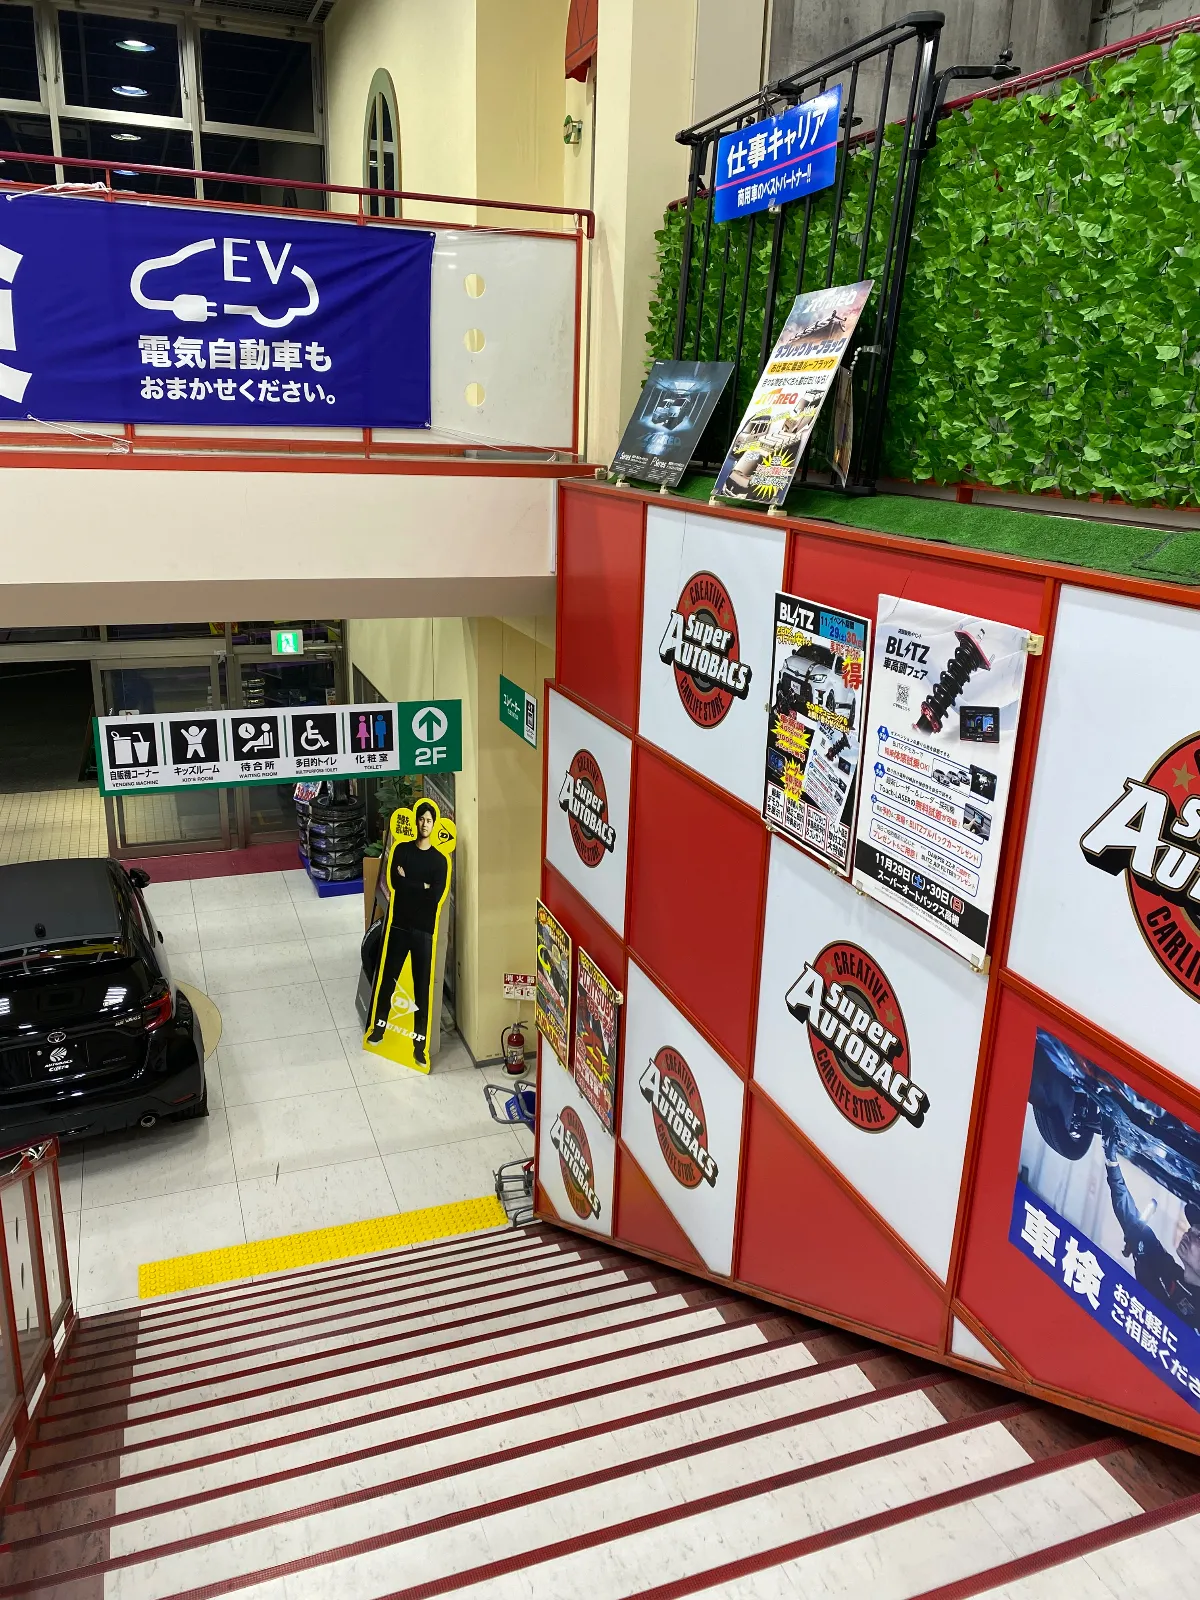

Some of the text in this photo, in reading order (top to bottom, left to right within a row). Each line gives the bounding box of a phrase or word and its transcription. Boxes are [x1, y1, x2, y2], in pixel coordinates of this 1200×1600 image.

[727, 108, 829, 178] 仕事キャリア
[223, 237, 292, 285] EV
[138, 334, 332, 373] 電気自動車も
[140, 375, 336, 405] おまかせください。
[690, 580, 725, 613] CREATIVE
[780, 602, 815, 631] BLITZ
[659, 609, 751, 692] AUTOBACS
[685, 614, 732, 652] Super
[885, 635, 930, 665] BLITZ
[680, 676, 725, 722] CARLIFE STORE
[842, 662, 863, 691] 得
[110, 769, 160, 781] 自販機コーナー
[174, 764, 220, 776] キッズルーム
[240, 761, 275, 772] 待合所
[295, 756, 337, 768] 多目的トイレ
[355, 753, 389, 764] 化粧室
[415, 746, 447, 766] 2F
[576, 756, 600, 782] CREATIVE
[558, 770, 616, 848] AUTOBACS
[575, 779, 604, 812] Super
[875, 852, 965, 915] 11月29日(土)・30日(日)
[578, 968, 614, 1023] FUJITSUBO
[834, 951, 888, 1009] CREATIVE
[376, 1019, 426, 1042] DUNLOP
[785, 962, 928, 1118] AUTOBACS
[825, 981, 900, 1055] Super
[664, 1053, 696, 1098] CREATIVE
[816, 1048, 886, 1123] CARLIFE STORE
[639, 1058, 716, 1178] AUTOBACS
[661, 1075, 702, 1131] Super
[550, 1114, 599, 1212] AUTOBACS
[564, 1129, 590, 1176] Super
[658, 1122, 696, 1182] CARLIFE STORE
[1020, 1200, 1105, 1311] 車検
[1113, 1283, 1179, 1353] お気軽に
